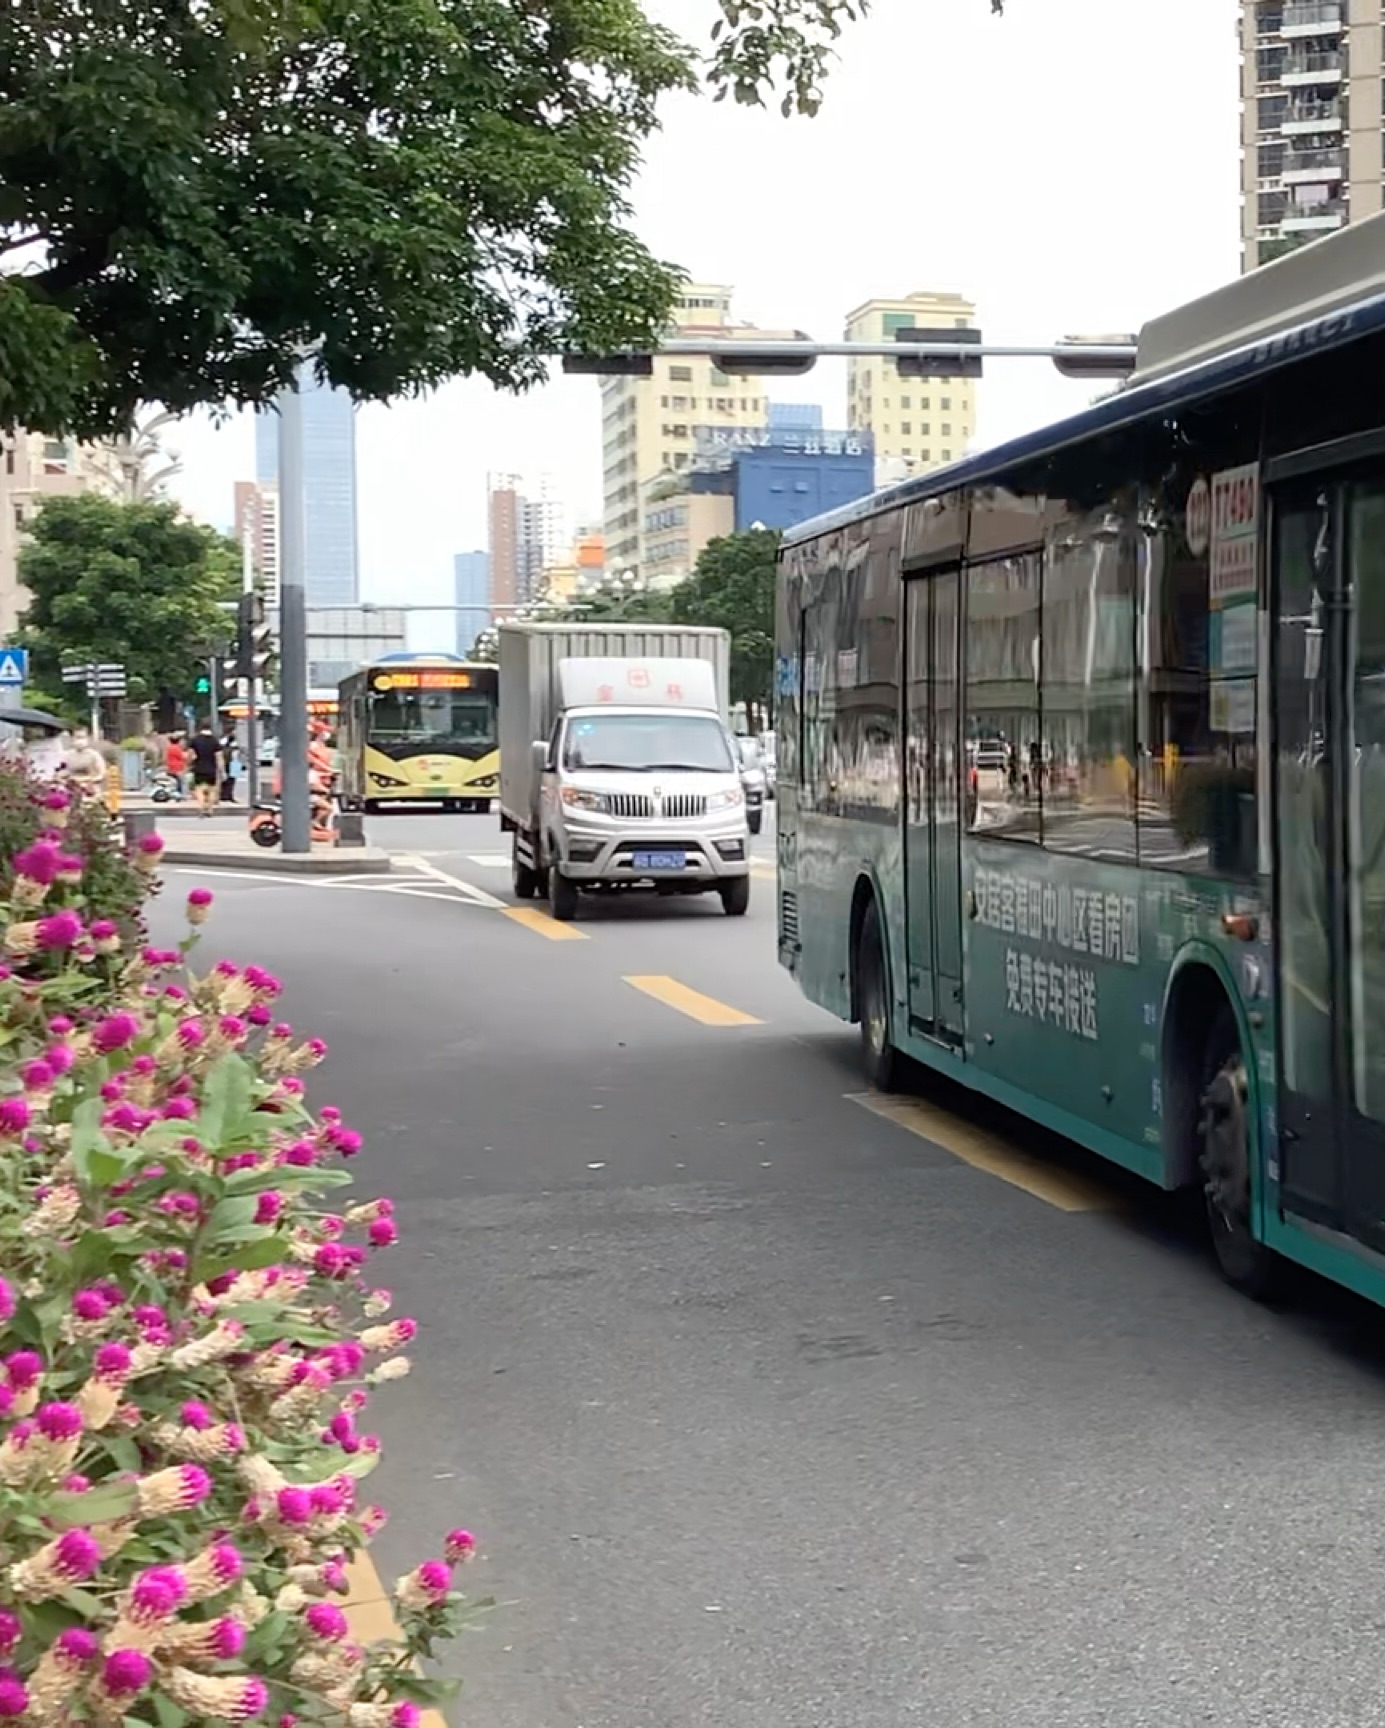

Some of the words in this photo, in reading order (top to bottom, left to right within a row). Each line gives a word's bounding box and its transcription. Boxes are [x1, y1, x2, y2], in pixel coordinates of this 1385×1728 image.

[1006, 947, 1099, 1041] 免费专车接送
